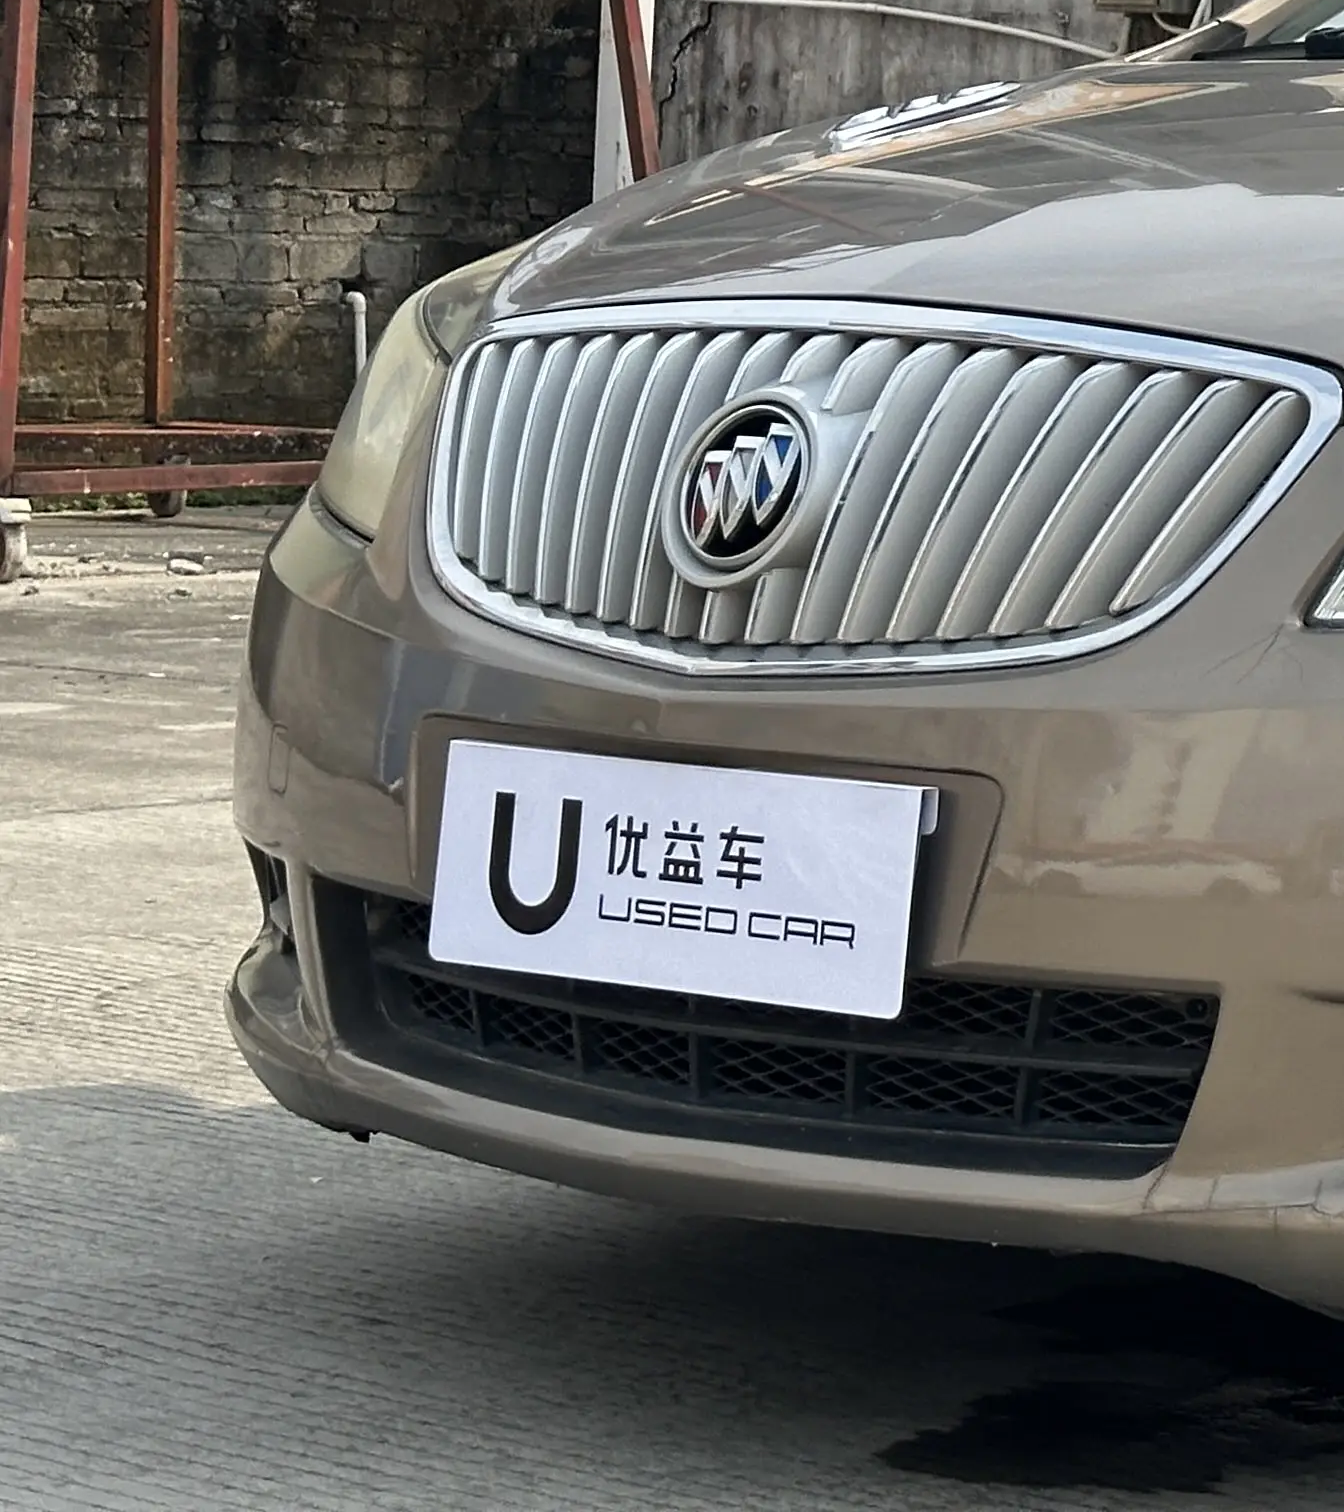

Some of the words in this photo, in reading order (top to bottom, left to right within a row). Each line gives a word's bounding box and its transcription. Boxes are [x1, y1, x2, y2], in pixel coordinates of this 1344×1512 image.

[490, 791, 583, 935] U
[604, 814, 765, 889] 优益车
[598, 894, 739, 936] USED
[748, 913, 857, 950] CAR
